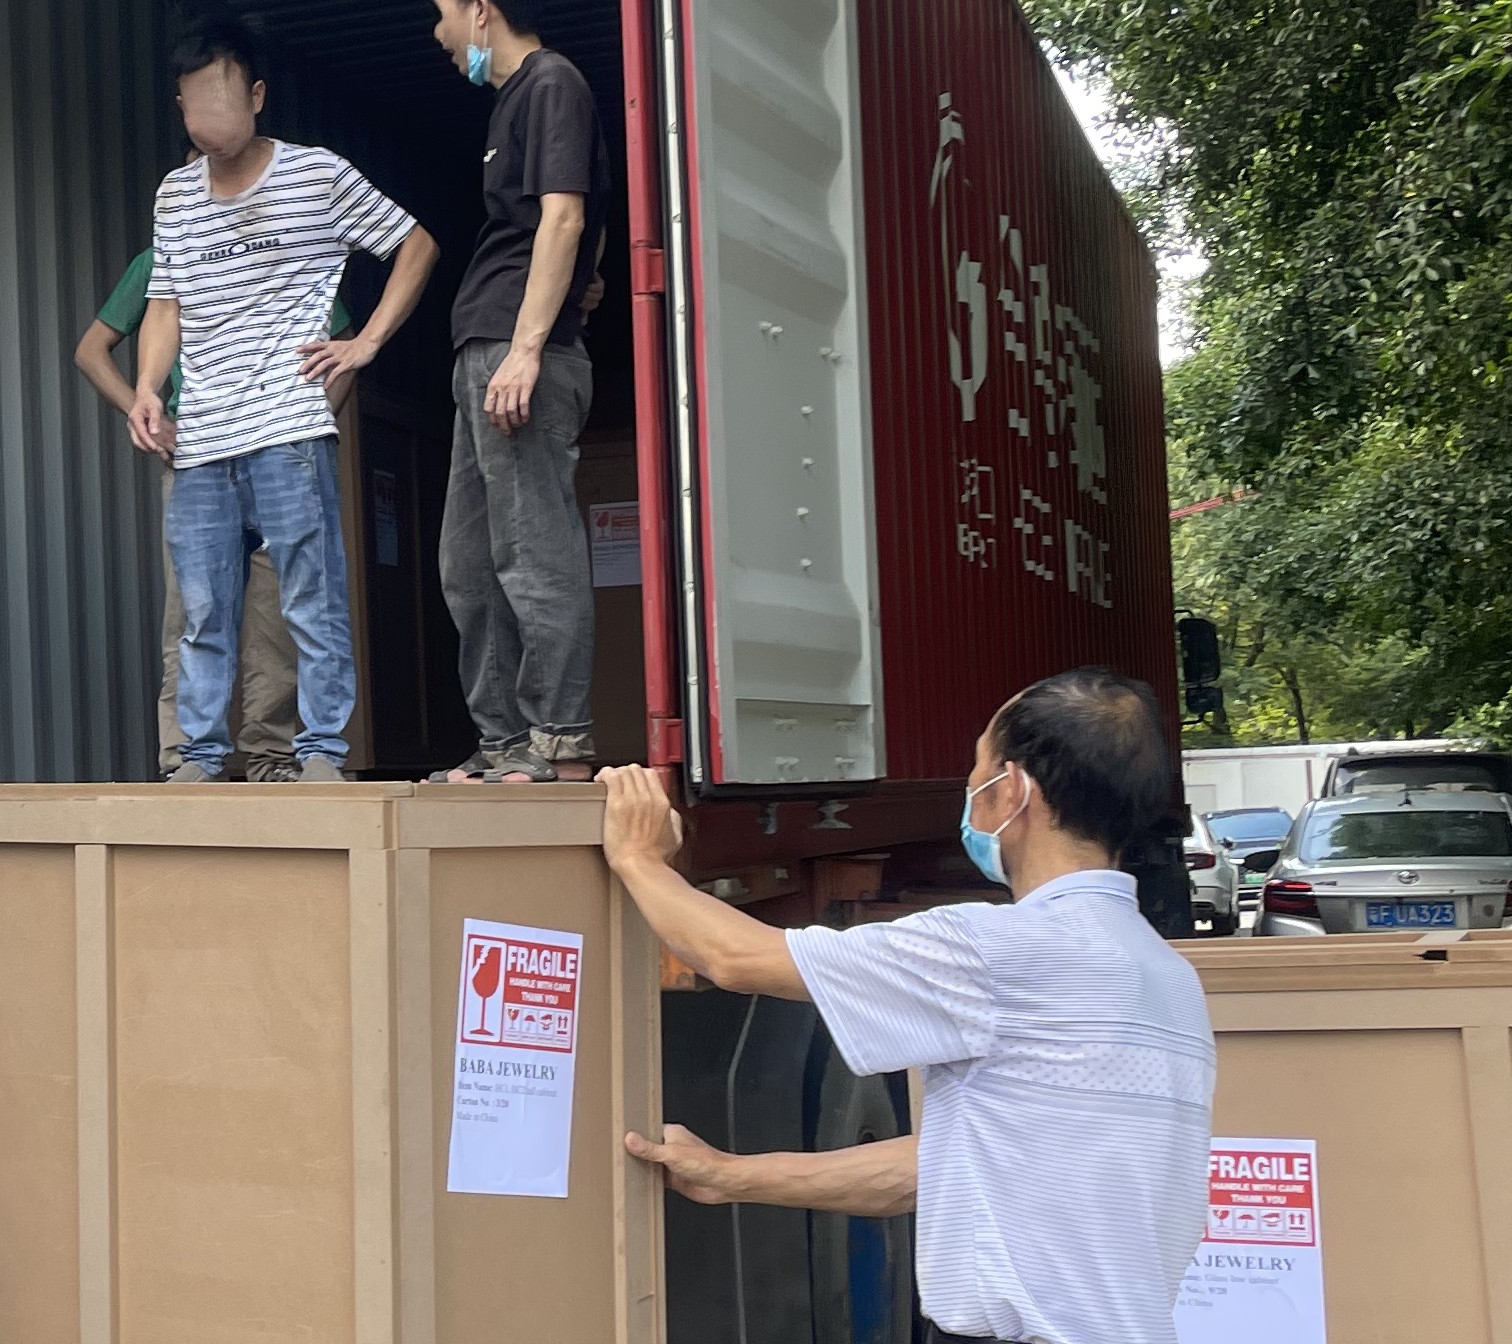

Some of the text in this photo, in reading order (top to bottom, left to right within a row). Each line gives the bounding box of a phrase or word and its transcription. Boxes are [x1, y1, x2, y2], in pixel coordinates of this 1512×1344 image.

[506, 945, 577, 979] FRAGILE
[459, 1057, 557, 1081] BABA JEWELRY
[1207, 1155, 1309, 1181] FRAGILE
[1204, 1254, 1296, 1271] JEWELRY
